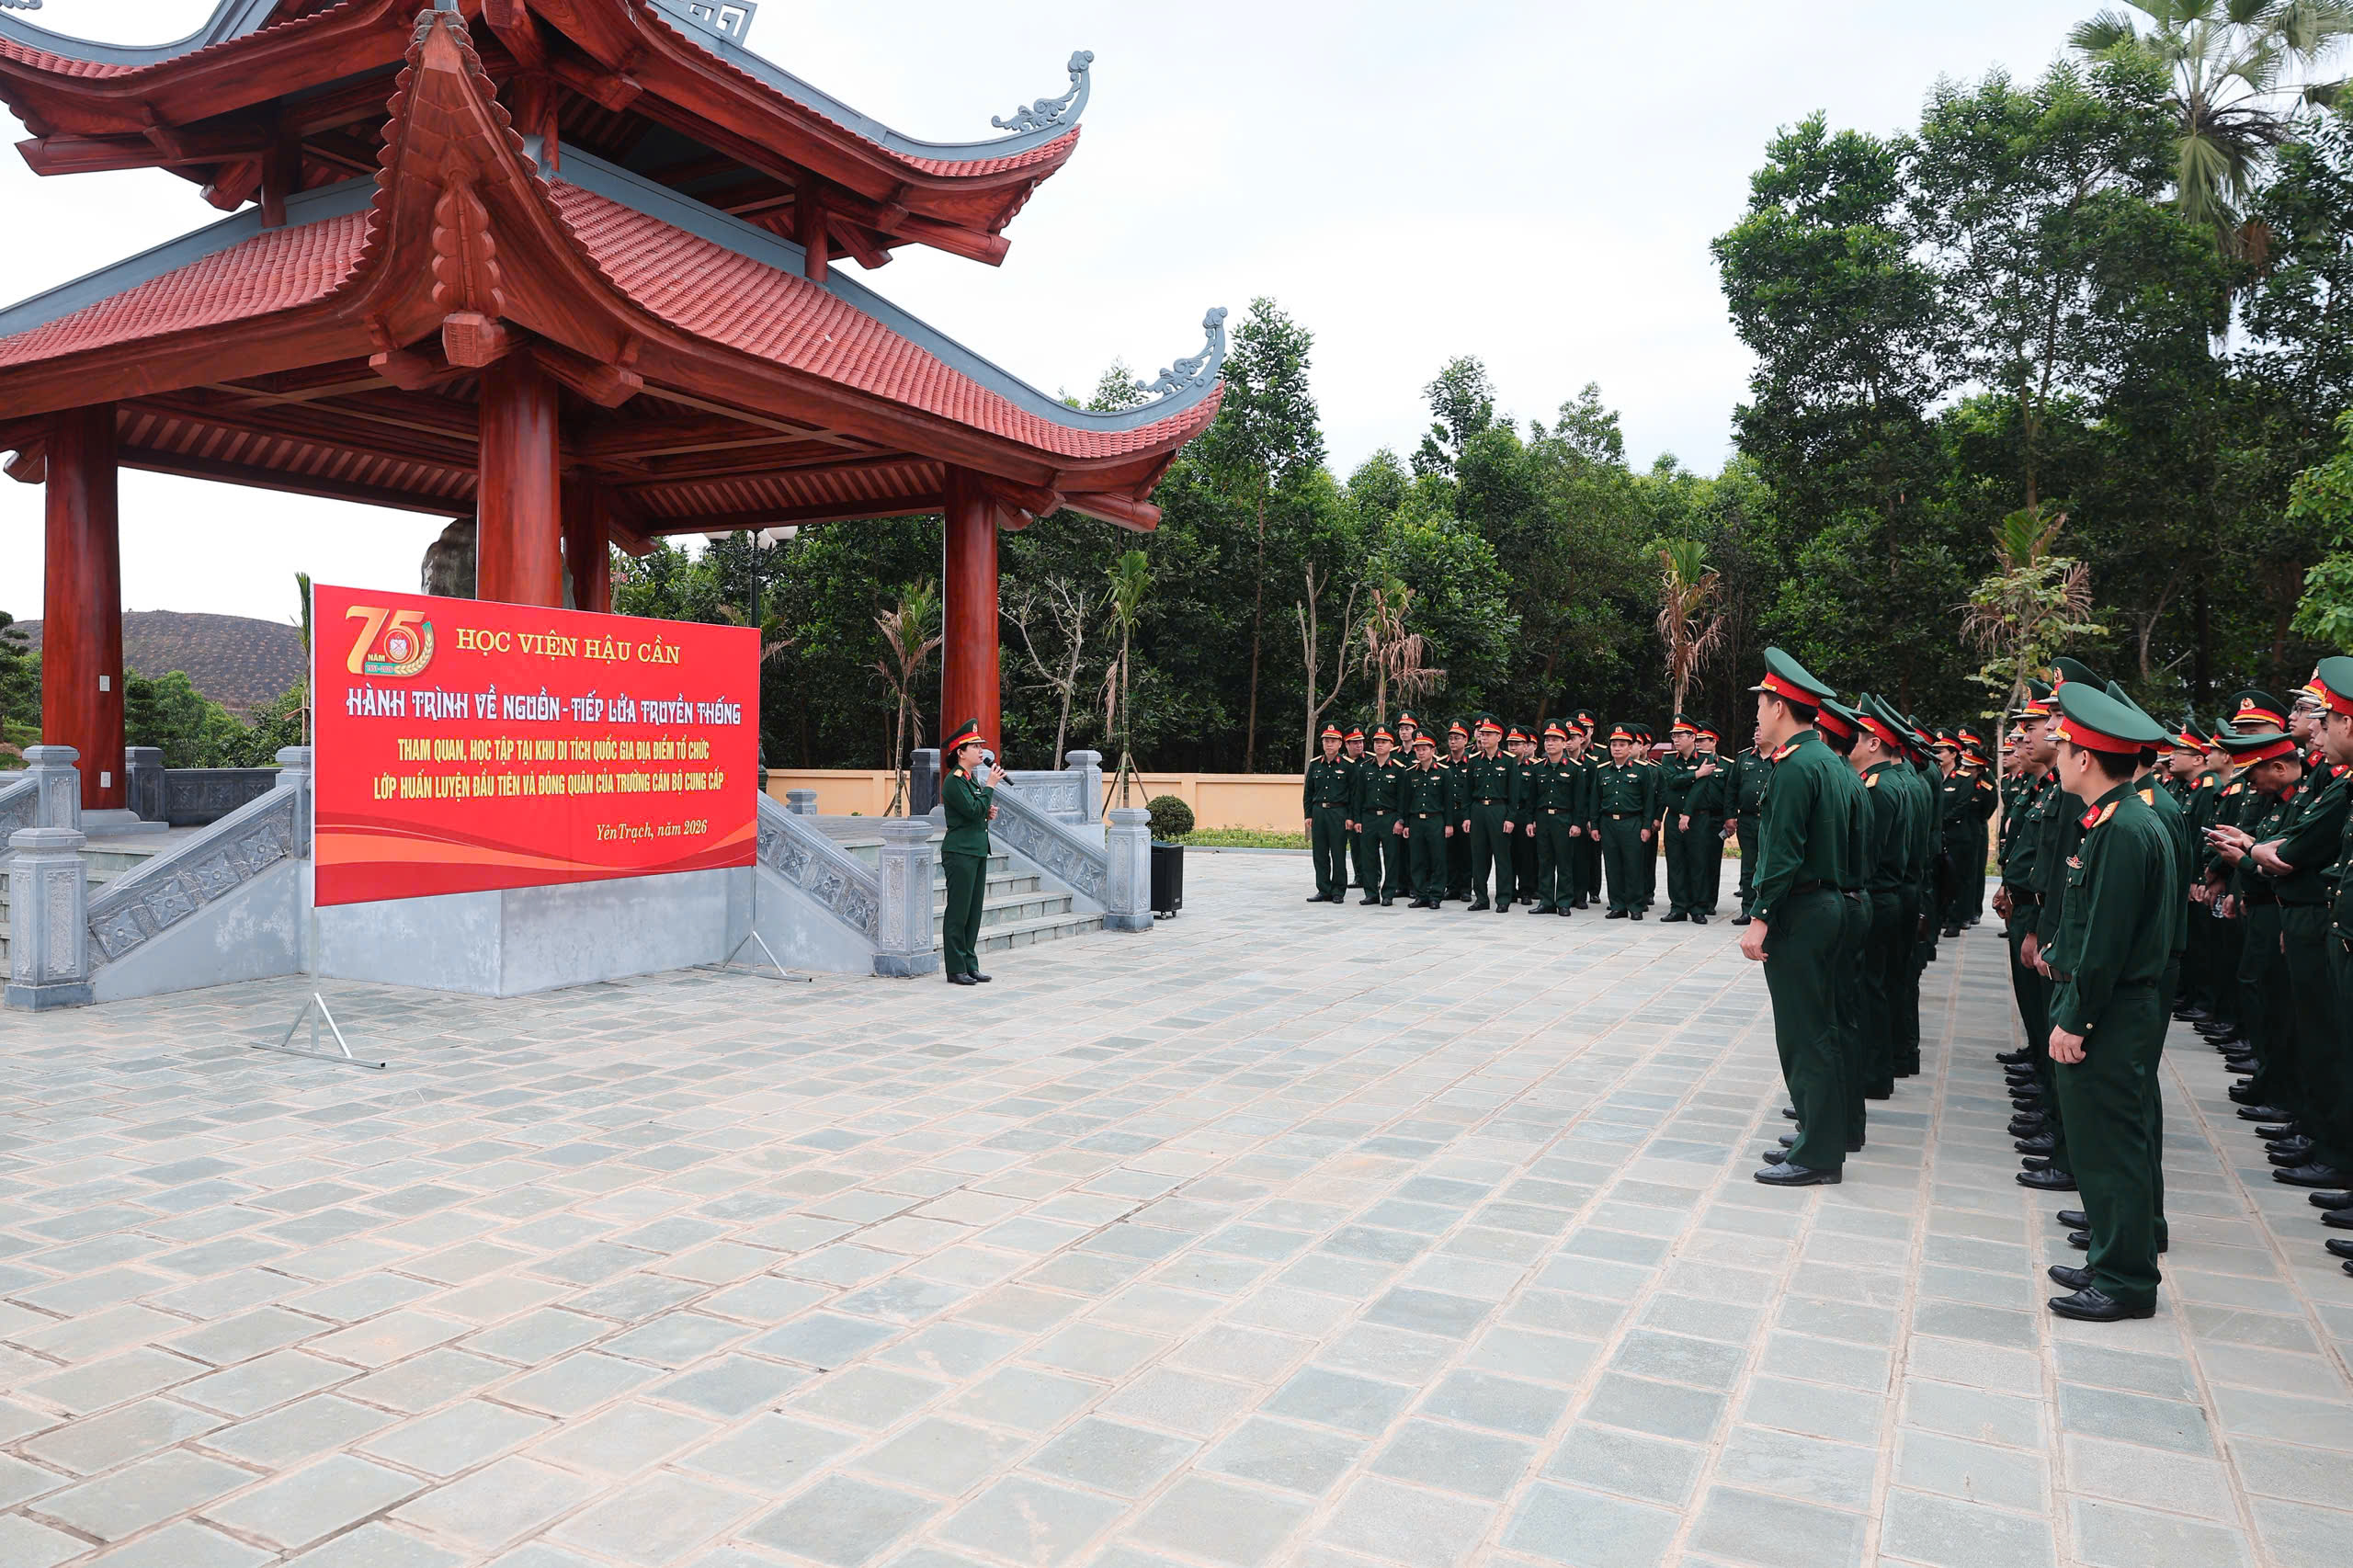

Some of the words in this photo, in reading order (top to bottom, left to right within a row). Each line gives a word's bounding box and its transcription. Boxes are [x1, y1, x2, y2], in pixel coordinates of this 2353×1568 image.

[346, 606, 425, 674] 75
[368, 653, 385, 662] NĂM
[456, 628, 511, 656] HỌC
[517, 630, 577, 661] VIỆN
[584, 634, 631, 665] HẬU
[638, 634, 680, 664] CẦN
[346, 682, 405, 716] HÀNH
[412, 686, 469, 721] TRÌNH
[475, 684, 497, 720] VỀ
[503, 686, 560, 721] NGUỒN
[572, 690, 603, 722] TIẾP
[608, 693, 636, 723] LỬA
[641, 693, 693, 726] TRUYỀN
[697, 696, 741, 724] THỐNG
[398, 739, 430, 761] THAM
[434, 739, 467, 763] QUAN,
[471, 740, 492, 766] HỌC
[494, 735, 514, 765] TẬP
[517, 741, 532, 765] TẠI
[536, 741, 555, 760] KHU
[558, 741, 567, 760] DI
[570, 737, 590, 760] TÍCH
[593, 734, 617, 762] QUỐC
[620, 741, 634, 760] GIA
[636, 742, 651, 764] ĐỊA
[654, 734, 674, 760] ĐIỂM
[676, 734, 687, 759] TỔ
[689, 738, 710, 759] CHỨC
[374, 772, 397, 800] LỚP
[401, 768, 432, 799] HUẤN
[436, 772, 470, 802] LUYỆN
[472, 768, 494, 797] ĐẦU
[497, 771, 520, 796] TIÊN
[523, 771, 536, 795] VÀ
[539, 770, 564, 794] ĐÓNG
[568, 770, 593, 797] QUÂN
[596, 767, 614, 793] CỦA
[617, 769, 650, 792] TRƯỜNG
[653, 770, 669, 791] CÁN
[672, 768, 682, 795] BỘ
[685, 772, 706, 790] CUNG
[708, 766, 723, 790] CẤP
[597, 824, 618, 840] Yên
[619, 823, 654, 843] Trạch,
[657, 823, 681, 836] năm
[684, 820, 708, 835] 2026
